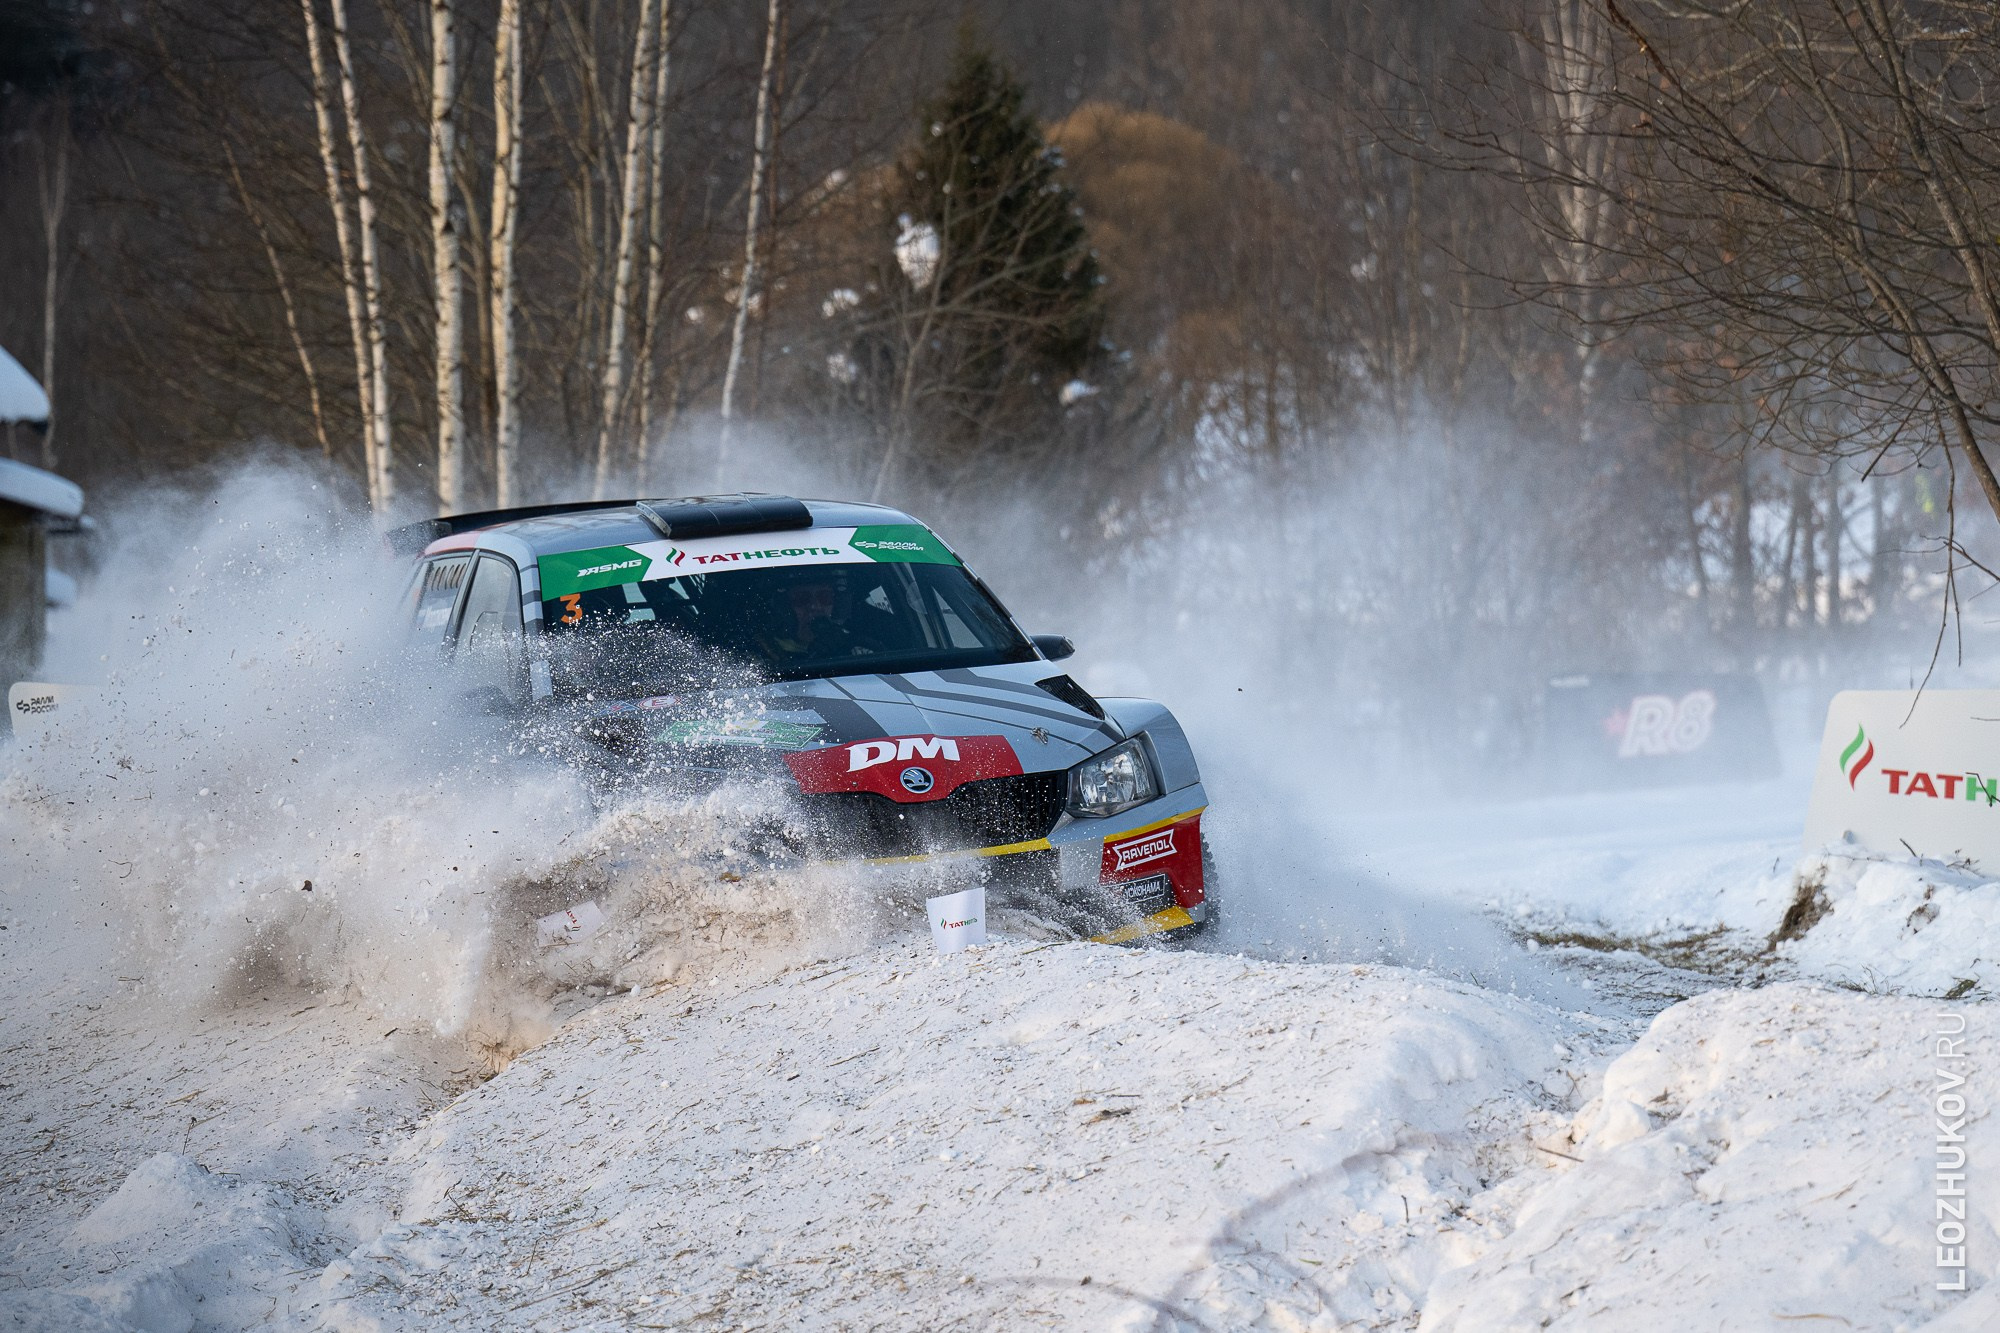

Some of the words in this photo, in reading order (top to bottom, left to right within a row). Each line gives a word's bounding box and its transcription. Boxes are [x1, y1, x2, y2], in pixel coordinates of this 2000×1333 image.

[692, 547, 840, 565] ТАТНЕФТЬ
[560, 593, 583, 624] 3
[845, 737, 960, 773] DM
[1122, 839, 1170, 861] RAVENOL
[1124, 881, 1161, 898] YOKOHAMA
